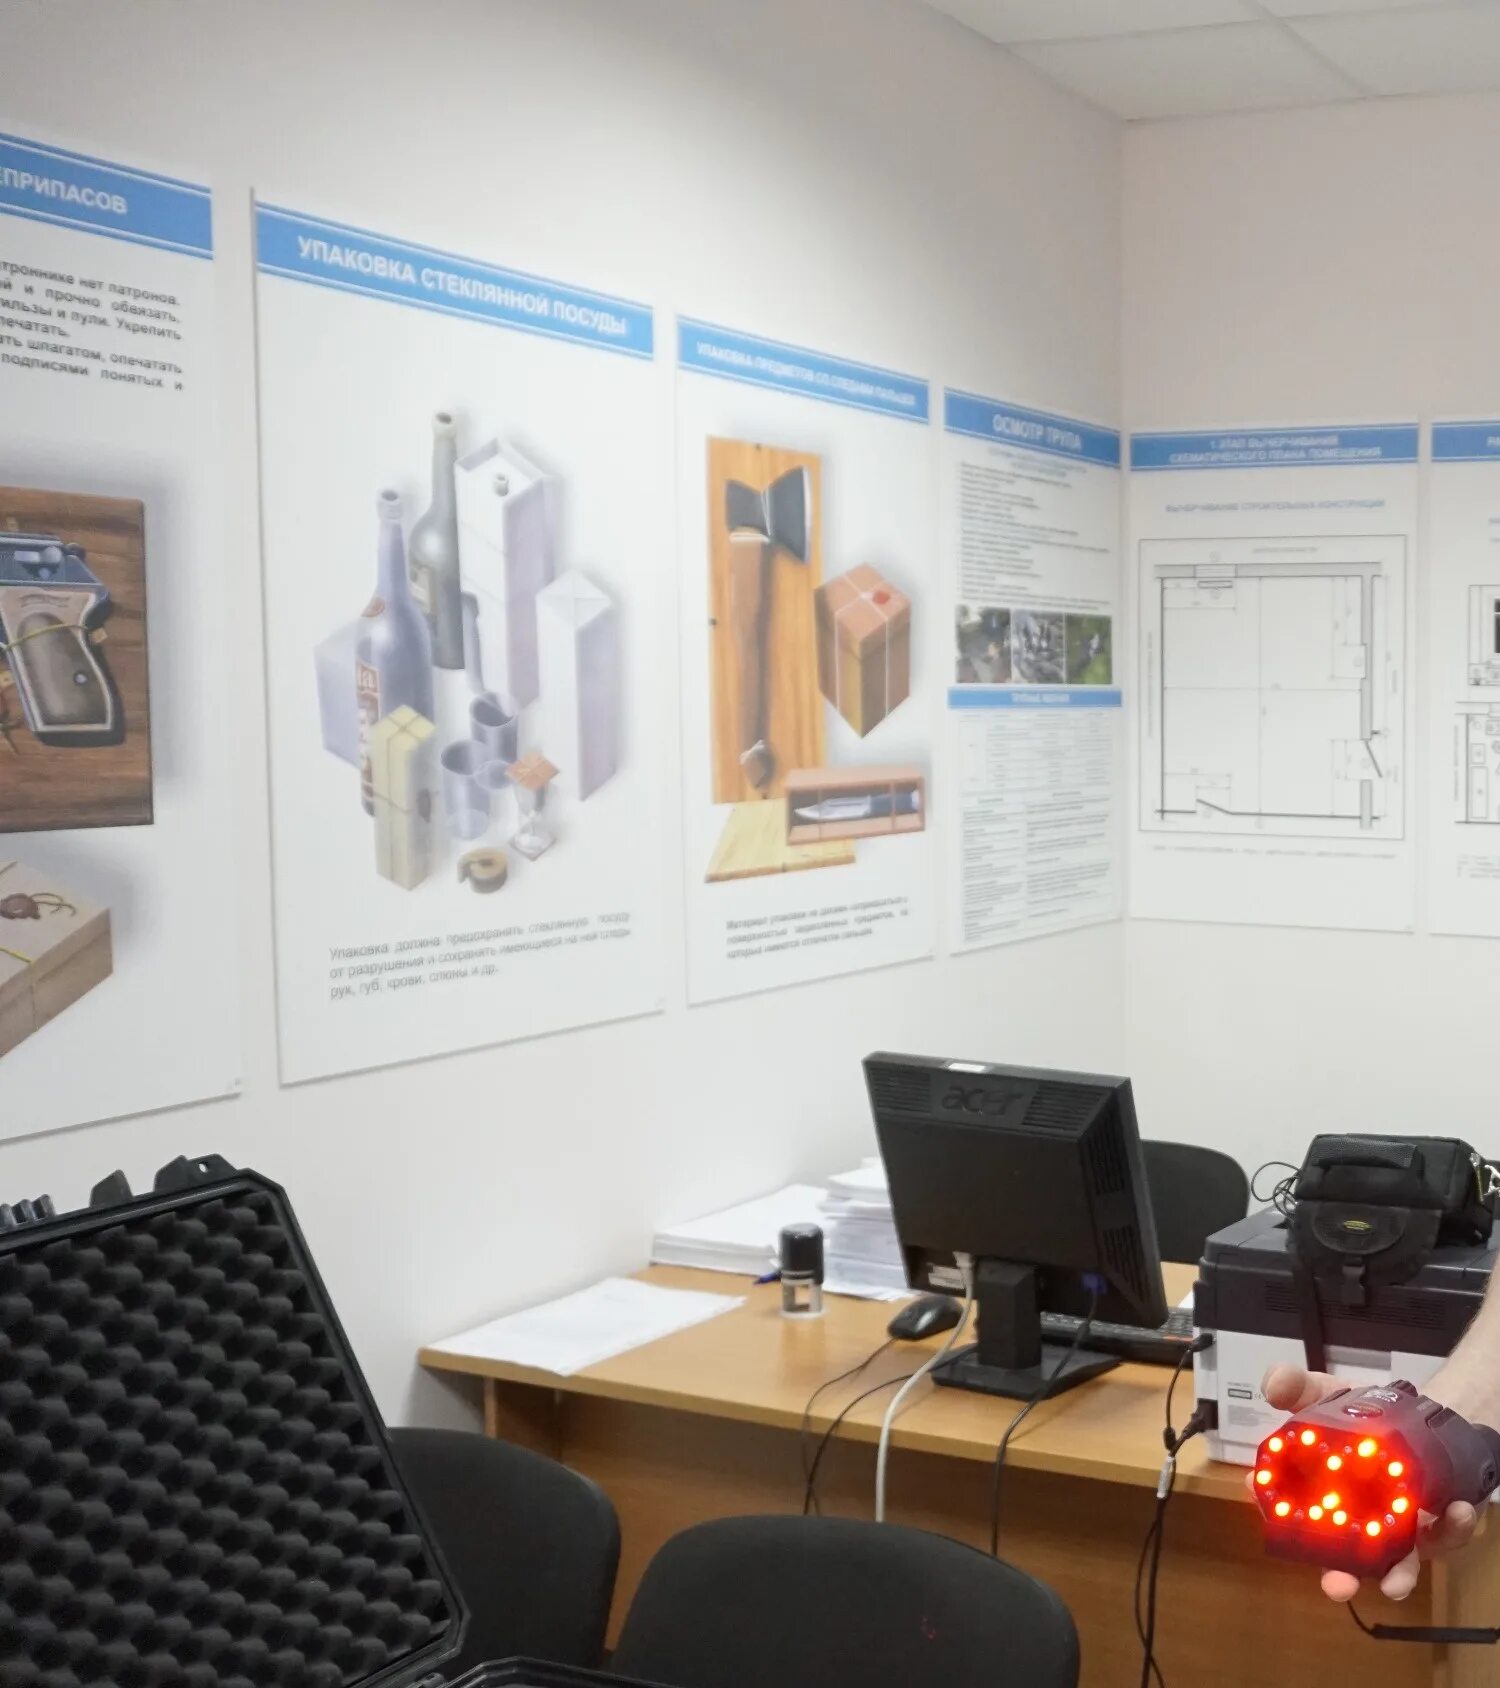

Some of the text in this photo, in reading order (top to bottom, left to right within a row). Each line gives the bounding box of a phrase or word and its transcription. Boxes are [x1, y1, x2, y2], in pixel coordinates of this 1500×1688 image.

[24, 284, 34, 295] и
[45, 288, 101, 308] прочно
[79, 276, 105, 291] нет
[108, 283, 180, 305] патронов.
[297, 234, 628, 336] УПАКОВКА СТЕКЛЯННОЙ ПОСУДЫ
[56, 309, 66, 319] и
[116, 316, 182, 340] Укрепить
[1, 353, 184, 392] подписями понятых и
[109, 353, 182, 375] опечатать
[992, 413, 1082, 450] ОСМОТР ТРУПА
[329, 941, 390, 961] Упаковка
[394, 936, 441, 953] должна
[329, 966, 344, 980] от
[348, 955, 425, 978] разрушения
[428, 953, 436, 965] и
[941, 1085, 1023, 1116] acer
